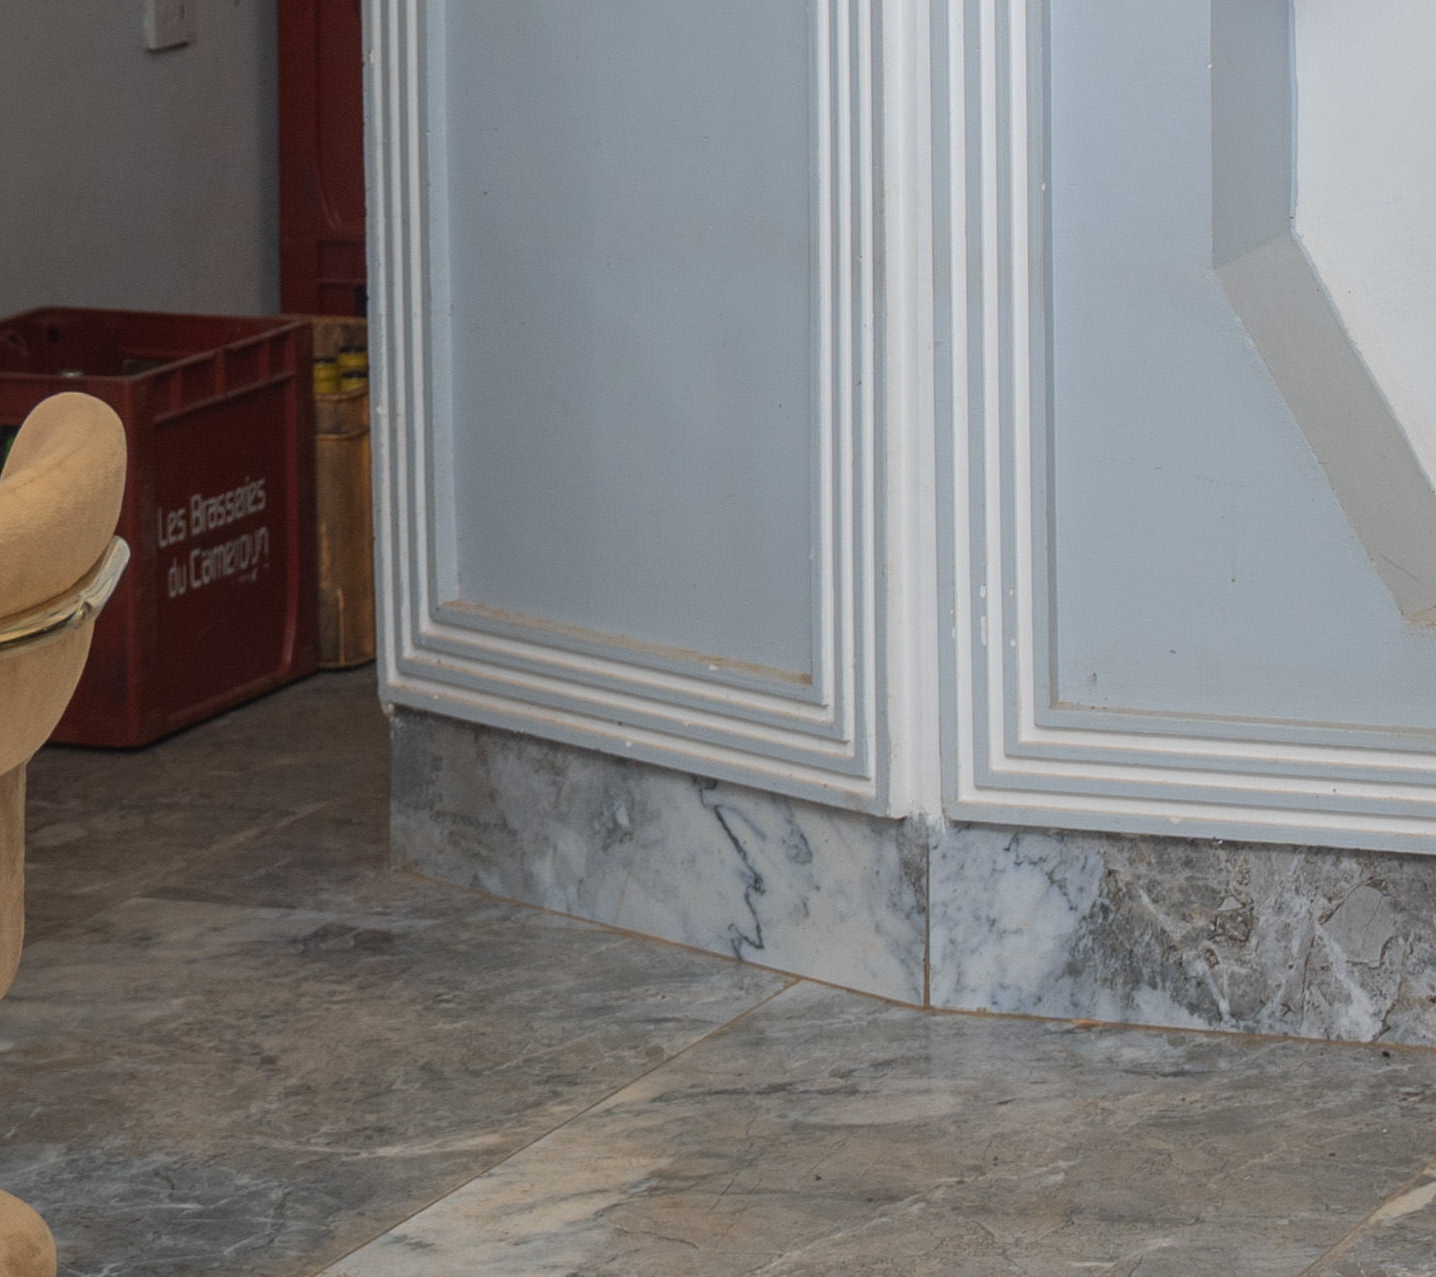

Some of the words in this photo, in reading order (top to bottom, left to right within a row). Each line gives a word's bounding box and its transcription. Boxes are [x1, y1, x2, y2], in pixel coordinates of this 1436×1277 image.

[157, 506, 186, 548] Les
[190, 476, 267, 535] Brasseries
[168, 556, 187, 598] du
[190, 526, 270, 589] Cameroun
